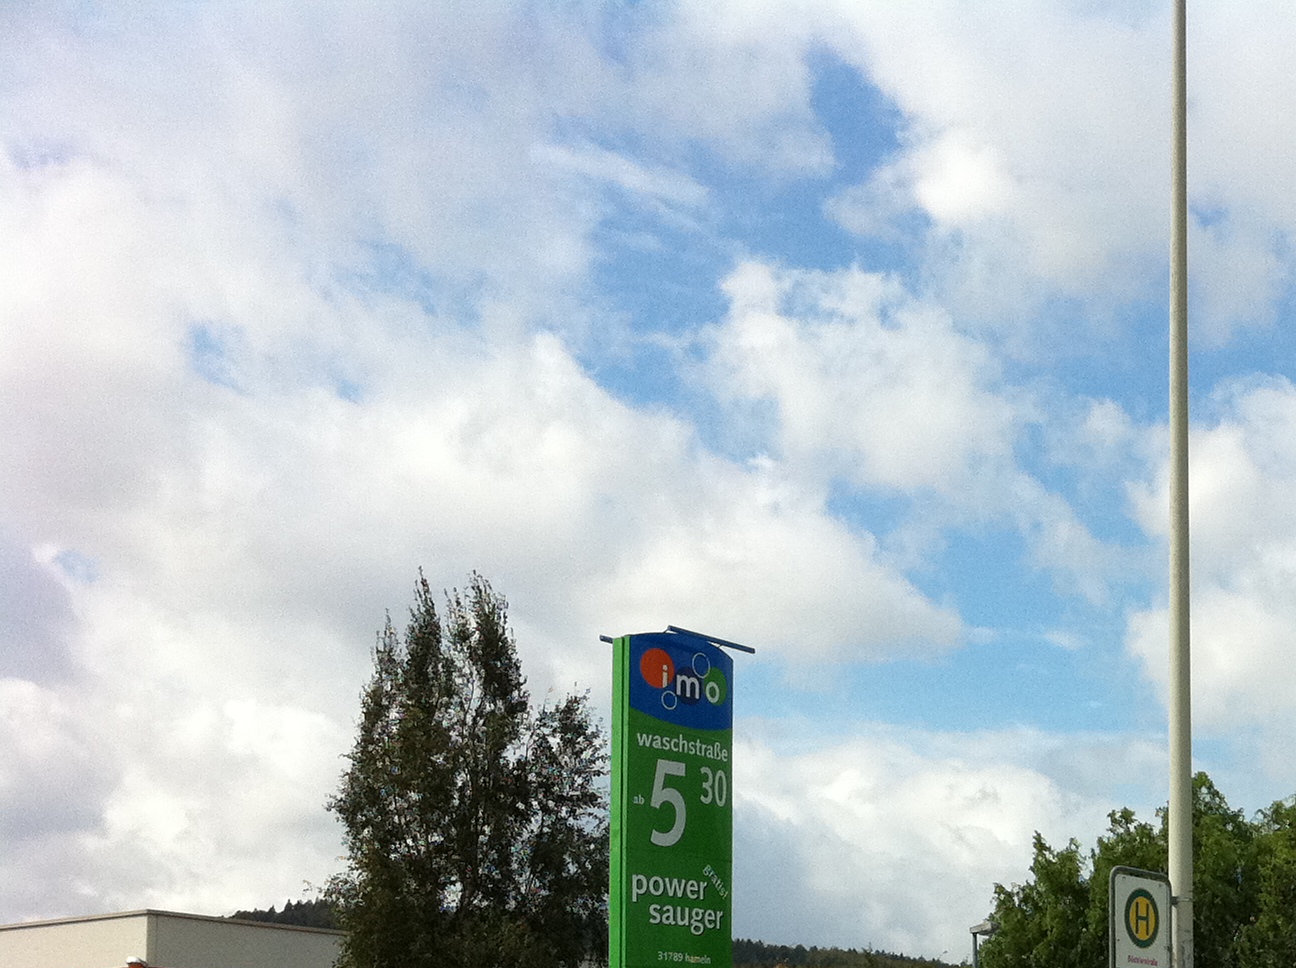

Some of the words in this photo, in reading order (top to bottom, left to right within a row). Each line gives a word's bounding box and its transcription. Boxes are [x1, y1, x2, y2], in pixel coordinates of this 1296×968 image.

[662, 664, 720, 703] imo
[636, 731, 728, 762] waschstraße
[633, 794, 645, 805] ab
[650, 758, 687, 847] 5
[700, 766, 727, 808] 30
[631, 873, 708, 902] power
[649, 903, 724, 935] sauger
[1136, 901, 1149, 936] H
[657, 951, 684, 962] 31789
